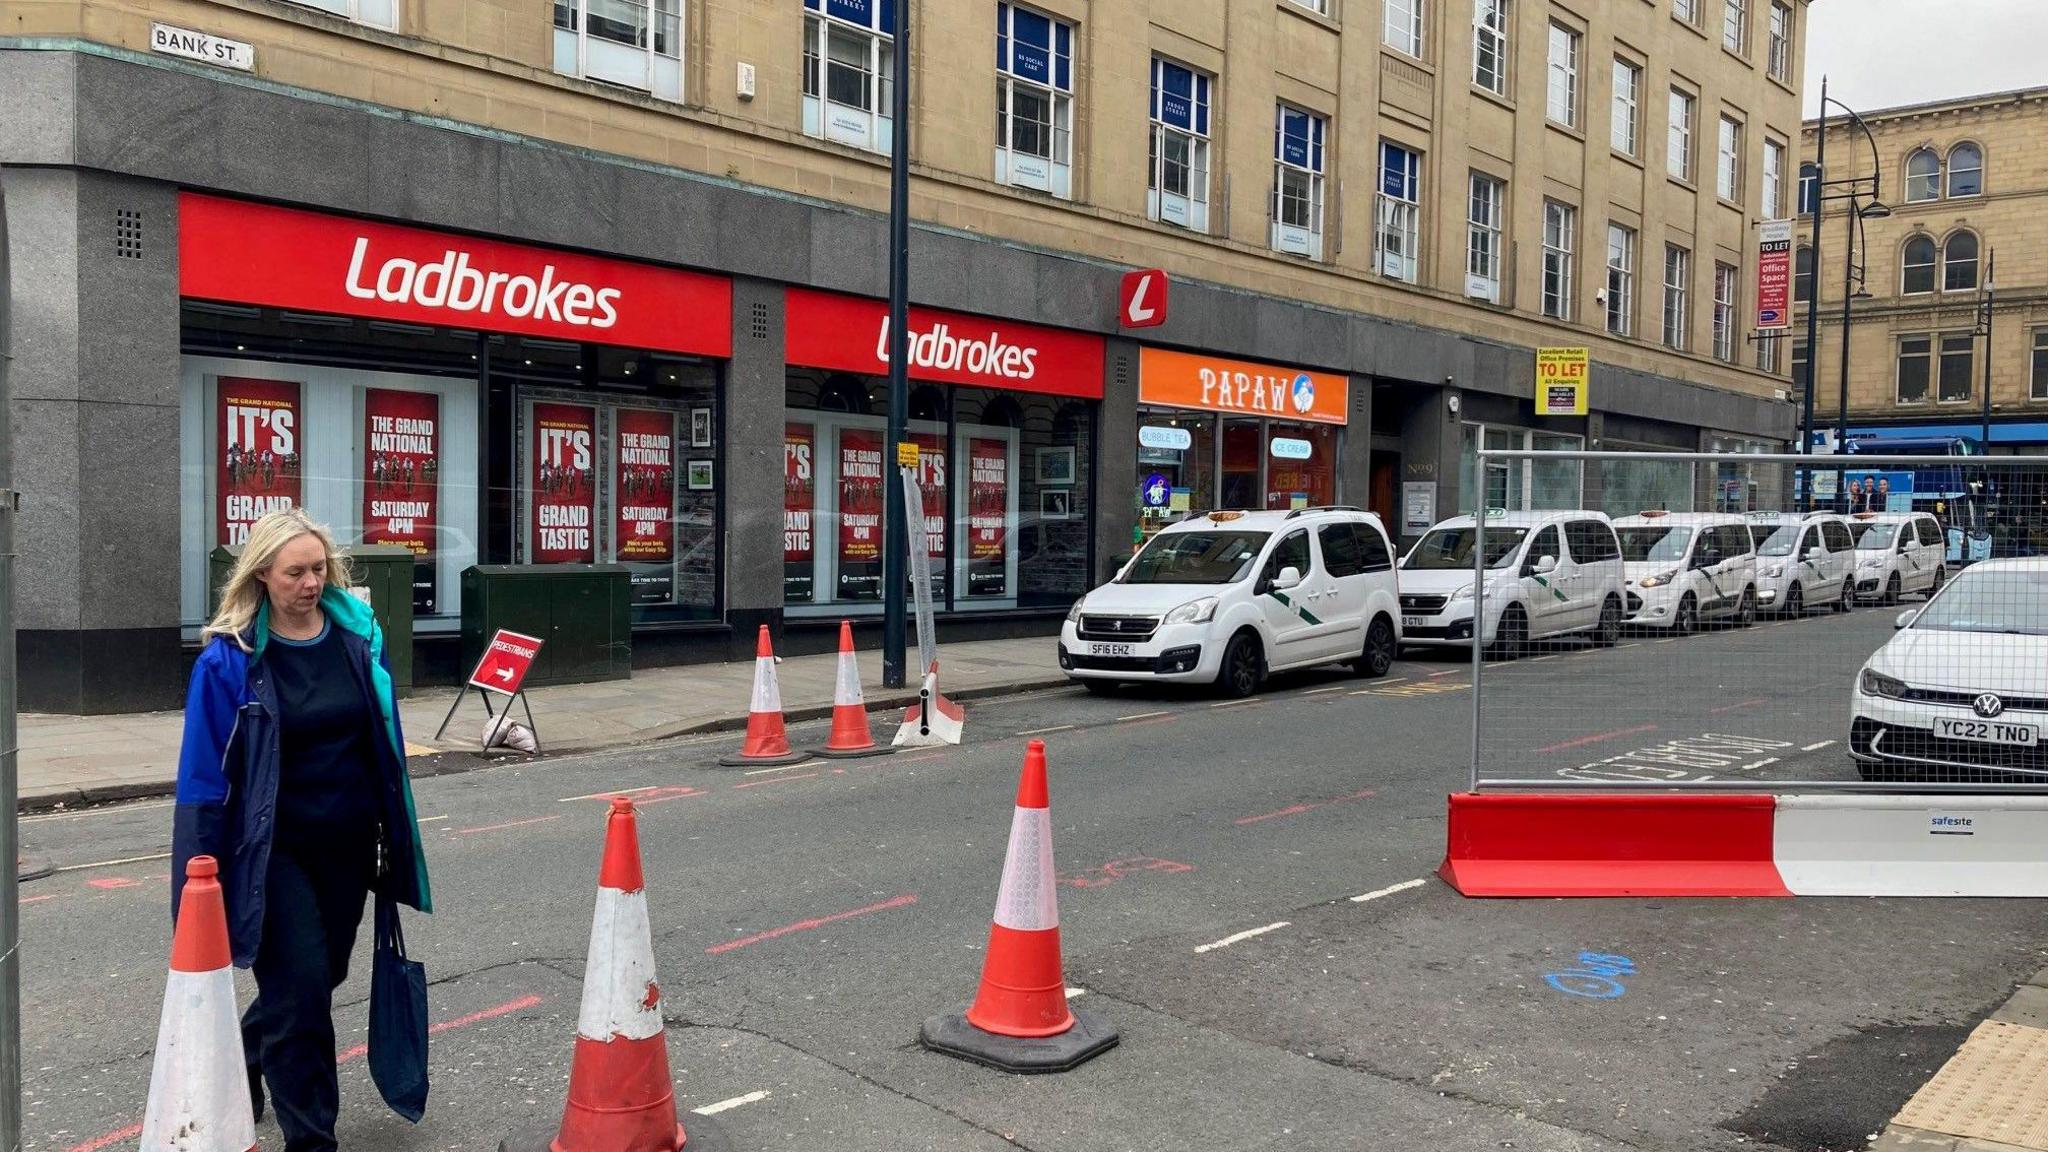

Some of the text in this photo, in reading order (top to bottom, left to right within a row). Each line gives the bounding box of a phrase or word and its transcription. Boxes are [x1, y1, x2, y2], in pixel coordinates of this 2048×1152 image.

[156, 31, 240, 62] BANK ST.
[1761, 242, 1789, 251] TO LET
[1762, 263, 1786, 273] Office
[345, 237, 622, 328] Ladbrokes
[1762, 274, 1786, 283] Space
[1128, 275, 1155, 322] L
[1539, 363, 1586, 376] TO LET
[1199, 368, 1289, 412] PAPAW
[240, 398, 262, 406] GRAND
[262, 400, 293, 408] NATIONAL
[227, 405, 294, 455] IT'S
[371, 416, 434, 435] THE GRAND
[371, 433, 434, 455] NATIONAL
[622, 433, 670, 449] THE GRAND
[1142, 431, 1189, 444] BUBBLE TEA
[540, 428, 590, 470] IT'S
[622, 448, 670, 466] NATIONAL
[843, 449, 881, 463] THE GRAND
[1274, 444, 1309, 454] ICE CREAM
[785, 444, 811, 480] T'S
[843, 462, 881, 478] NATIONAL
[972, 457, 1005, 470] THE GRAND
[972, 469, 1005, 483] NATIONAL
[371, 500, 429, 518] SATURDAY
[539, 504, 589, 527] GRAND
[622, 506, 668, 521] SATURDAY
[388, 518, 414, 534] 4PM
[635, 521, 656, 536] 4PM
[843, 514, 879, 527] SATURDAY
[925, 516, 944, 533] AND
[972, 517, 1002, 528] SATURDAY
[539, 528, 589, 550] TASTIC
[784, 532, 810, 551] STIC
[853, 527, 870, 540] 4PM
[980, 529, 995, 540] 4PM
[1409, 617, 1423, 625] GTU
[492, 640, 535, 659] PEDESTRIANS
[1092, 644, 1130, 655] SF16 EHZ
[1942, 720, 2030, 742] YC22 TNO
[1931, 816, 1973, 826] safesite
